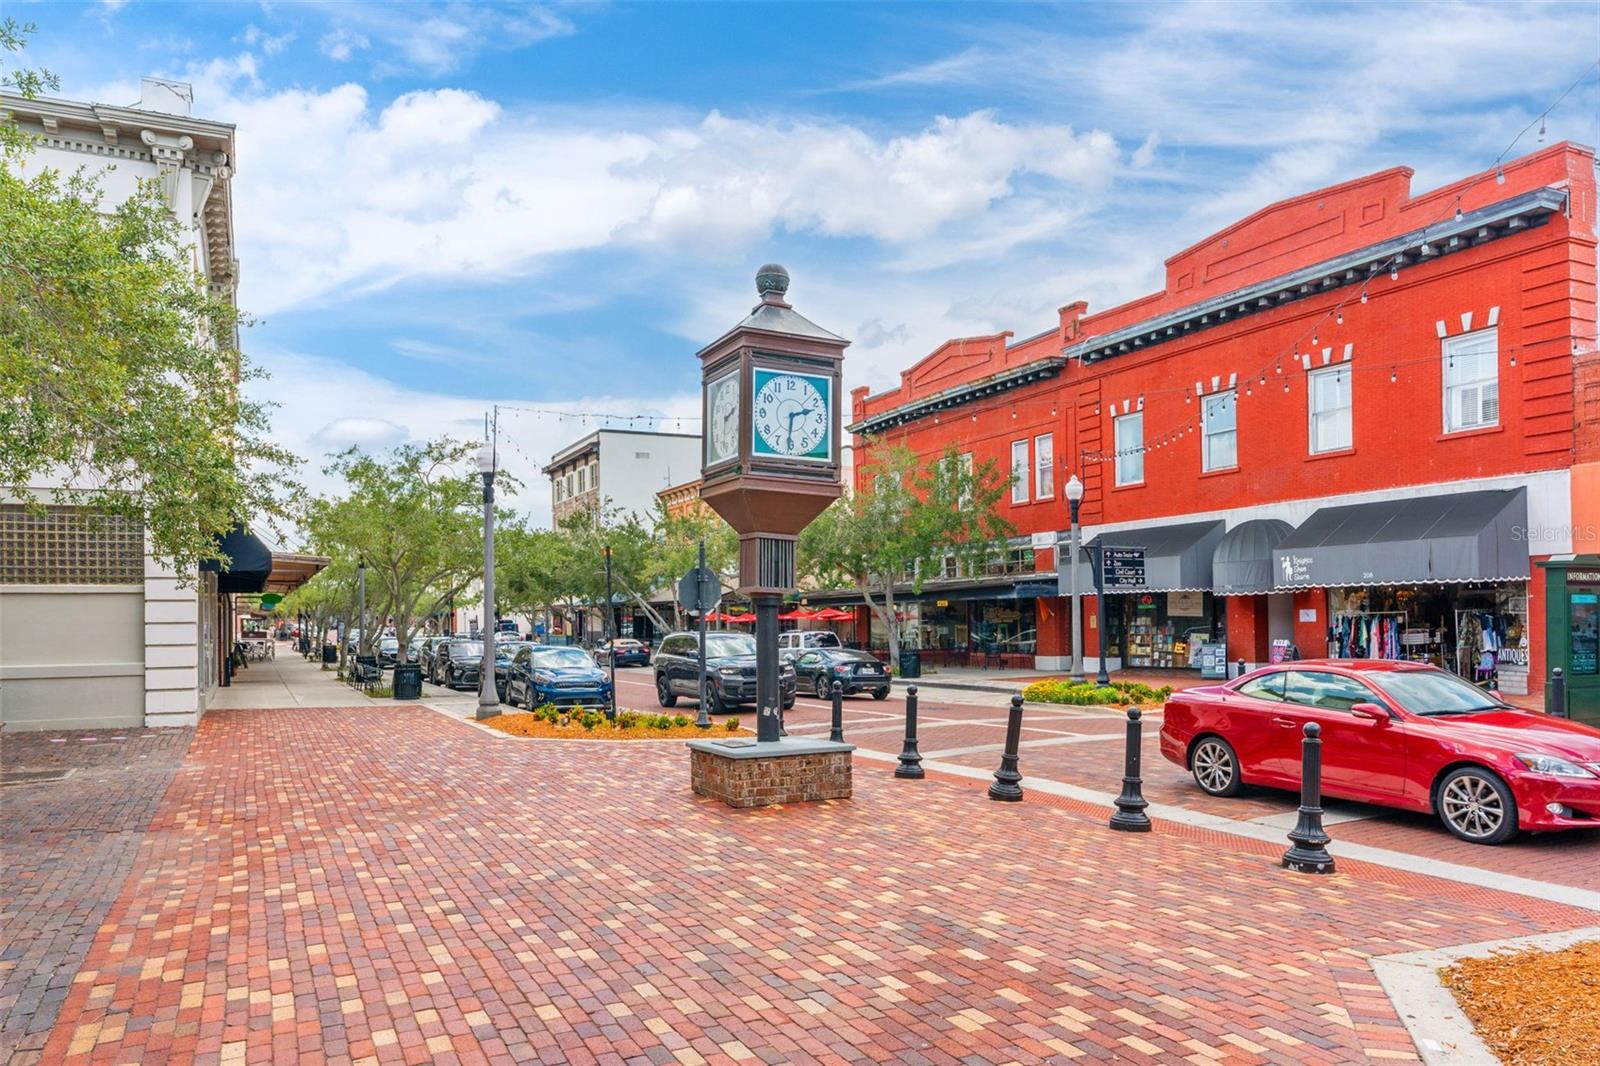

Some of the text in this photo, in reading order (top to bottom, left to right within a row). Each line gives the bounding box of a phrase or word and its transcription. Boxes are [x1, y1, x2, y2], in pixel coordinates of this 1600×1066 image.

[774, 382, 781, 393] 11
[787, 380, 796, 391] 12
[804, 385, 807, 396] 1
[764, 393, 774, 404] 10
[812, 398, 819, 408] 2
[759, 408, 766, 419] 9
[816, 413, 822, 424] 3
[764, 424, 771, 435] 8
[811, 428, 819, 438] 4
[775, 434, 782, 446] 7
[788, 439, 794, 450] 6
[801, 438, 809, 448] 5
[1498, 648, 1528, 663] ANTIQUES
